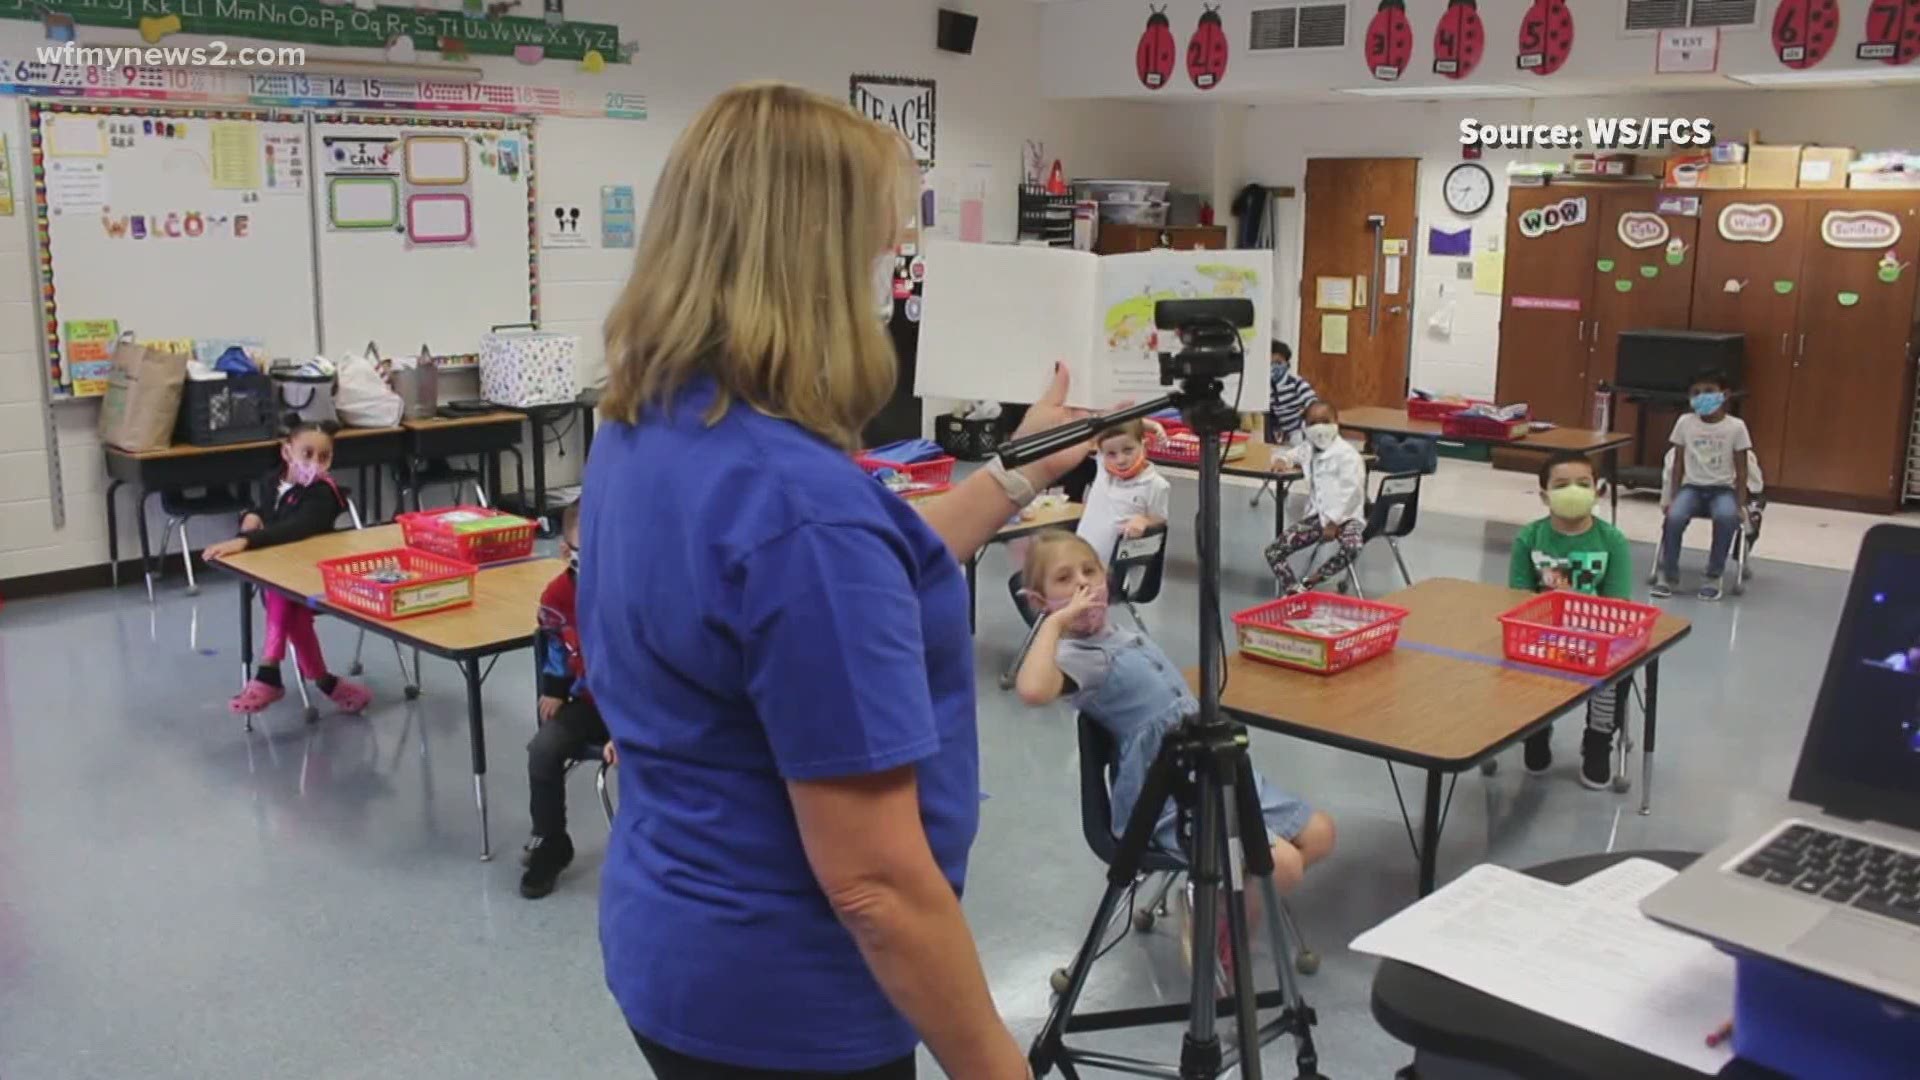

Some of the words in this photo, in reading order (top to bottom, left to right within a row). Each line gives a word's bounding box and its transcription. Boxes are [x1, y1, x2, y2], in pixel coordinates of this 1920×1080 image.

[216, 1, 255, 21] Mm
[258, 4, 286, 25] Nn
[289, 6, 318, 28] Oo
[321, 9, 344, 38] Pp
[351, 12, 383, 40] Qq
[387, 14, 409, 33] Rr
[415, 16, 435, 35] Ss
[439, 17, 457, 37] Tt
[464, 20, 487, 40] Uu
[491, 23, 511, 42] Vv
[513, 24, 543, 43] Ww
[548, 28, 568, 46] Xx
[574, 29, 592, 50] Yy
[597, 31, 615, 49] Zz
[1521, 21, 1544, 50] 5
[1779, 8, 1798, 43] 6
[1873, 5, 1900, 41] 7
[1188, 41, 1207, 67] 2
[1372, 33, 1386, 56] 3
[1438, 30, 1455, 57] 4
[15, 60, 30, 81] 6
[49, 64, 62, 82] 7
[86, 65, 99, 84] 8
[122, 66, 137, 85] 9
[167, 69, 188, 88] 10
[249, 75, 271, 95] 12
[291, 75, 311, 95] 13
[329, 78, 346, 96] 14
[362, 80, 382, 98] 15
[417, 81, 434, 99] 16
[466, 84, 482, 101] 17
[606, 92, 624, 109] 20
[351, 155, 376, 166] CAN
